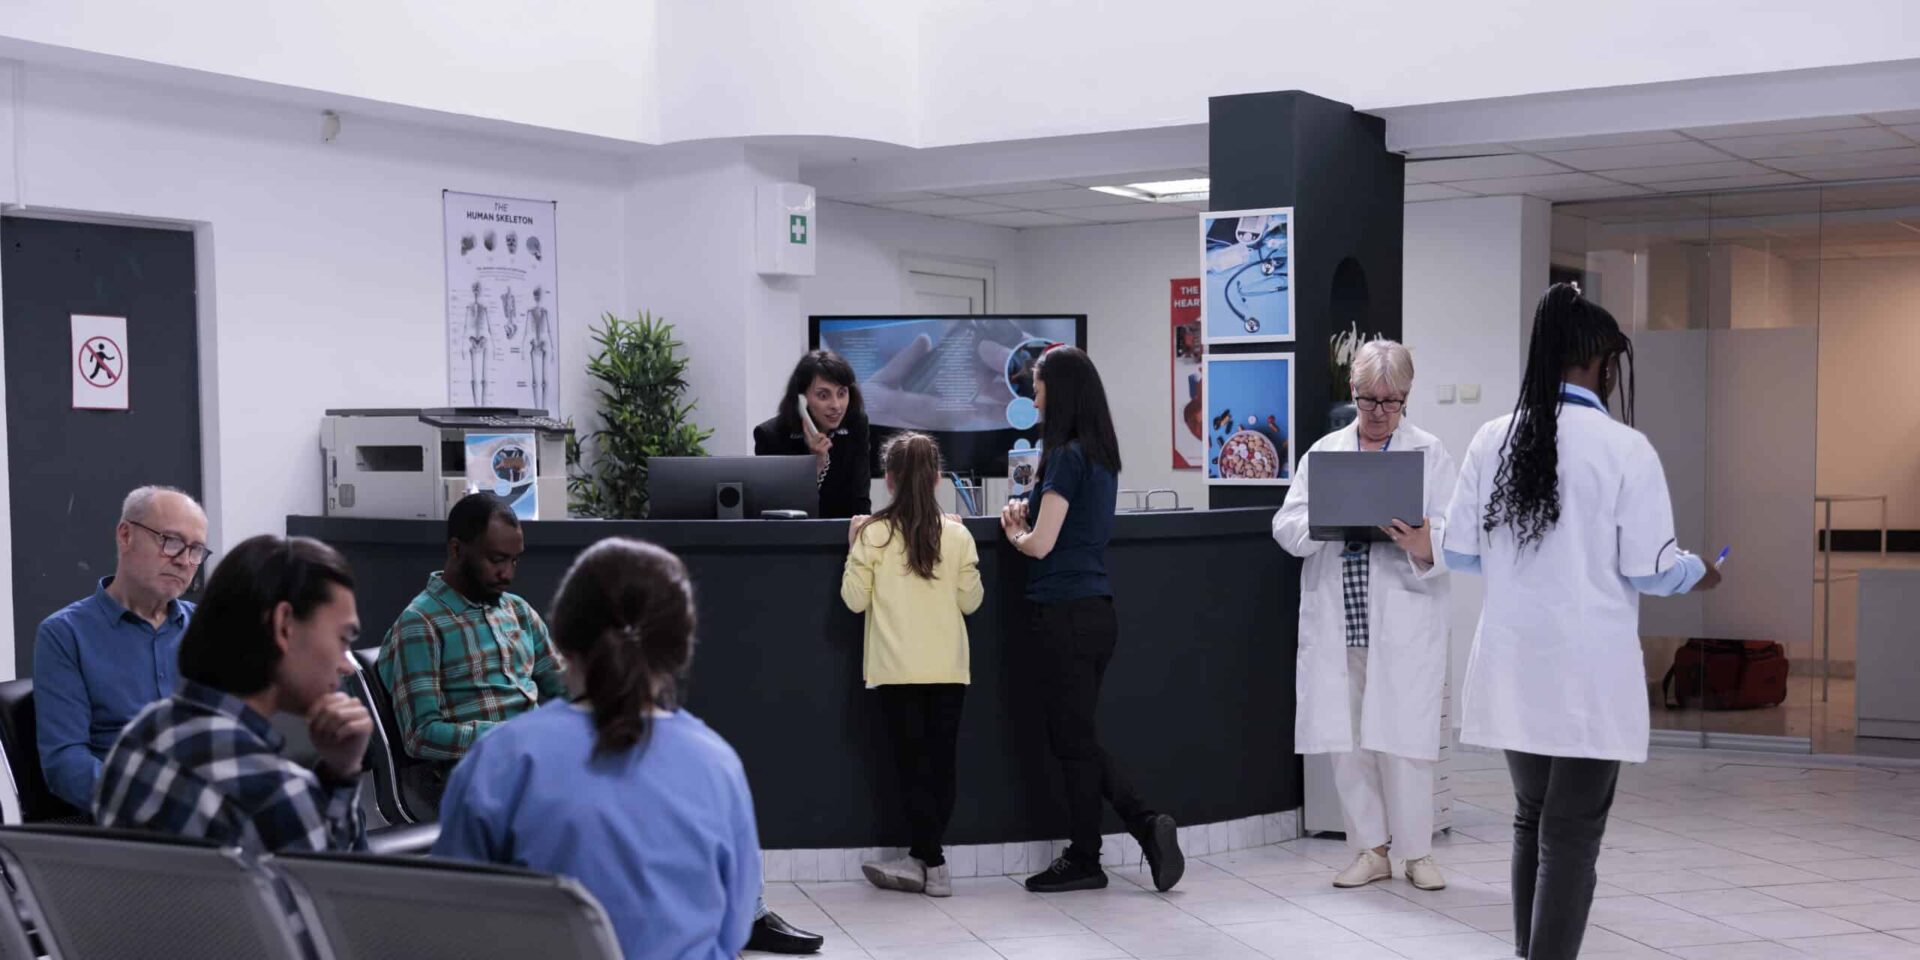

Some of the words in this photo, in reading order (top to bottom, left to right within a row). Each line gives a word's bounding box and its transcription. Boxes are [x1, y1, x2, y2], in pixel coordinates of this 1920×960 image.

[494, 202, 510, 212] THE
[466, 210, 495, 221] HUMAN
[495, 213, 534, 225] SKELETON
[1180, 285, 1200, 295] THE
